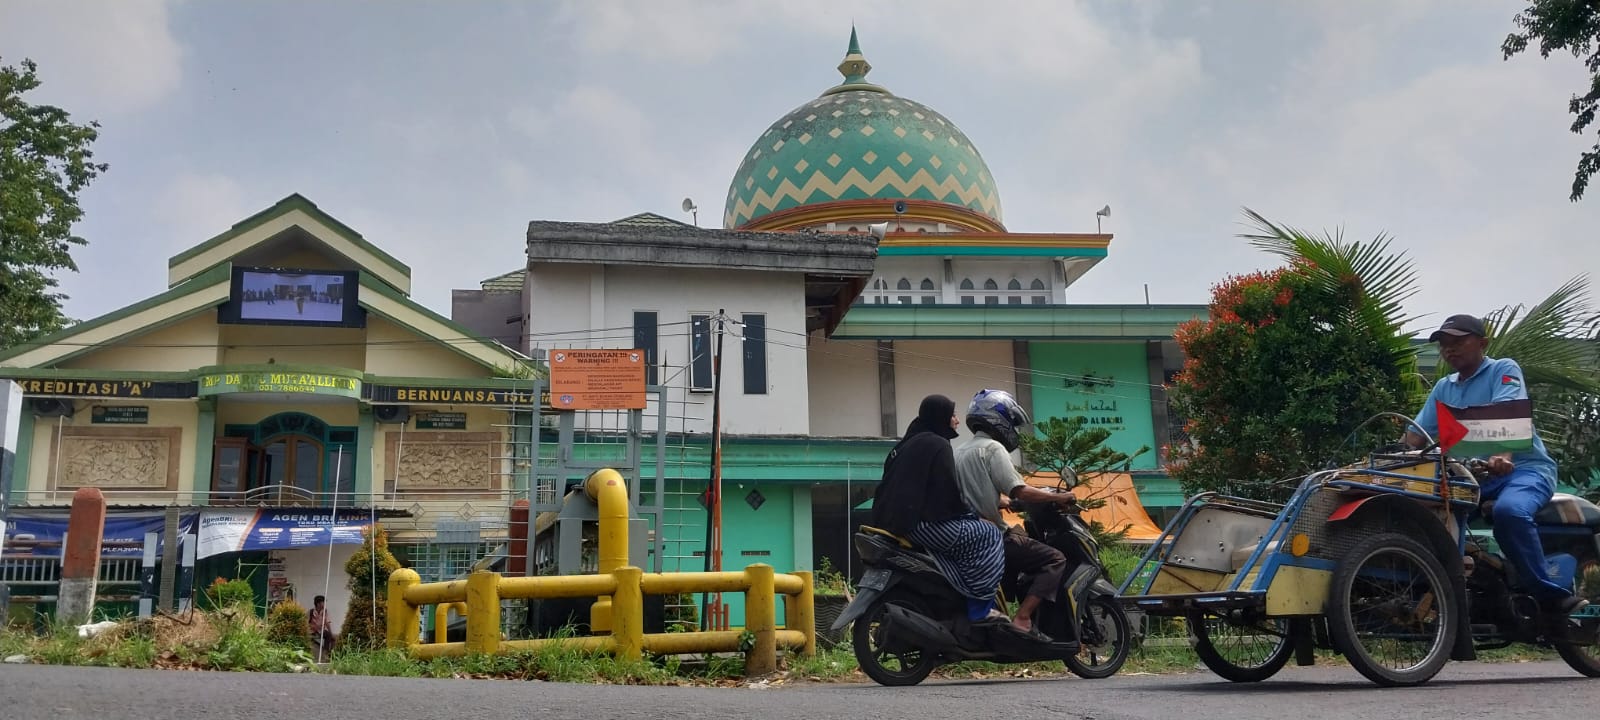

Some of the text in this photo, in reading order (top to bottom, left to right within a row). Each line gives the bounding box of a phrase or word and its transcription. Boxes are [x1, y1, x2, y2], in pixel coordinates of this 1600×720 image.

[397, 388, 497, 402] BERNUANSA
[272, 514, 369, 522] AGEN BRI LINK
